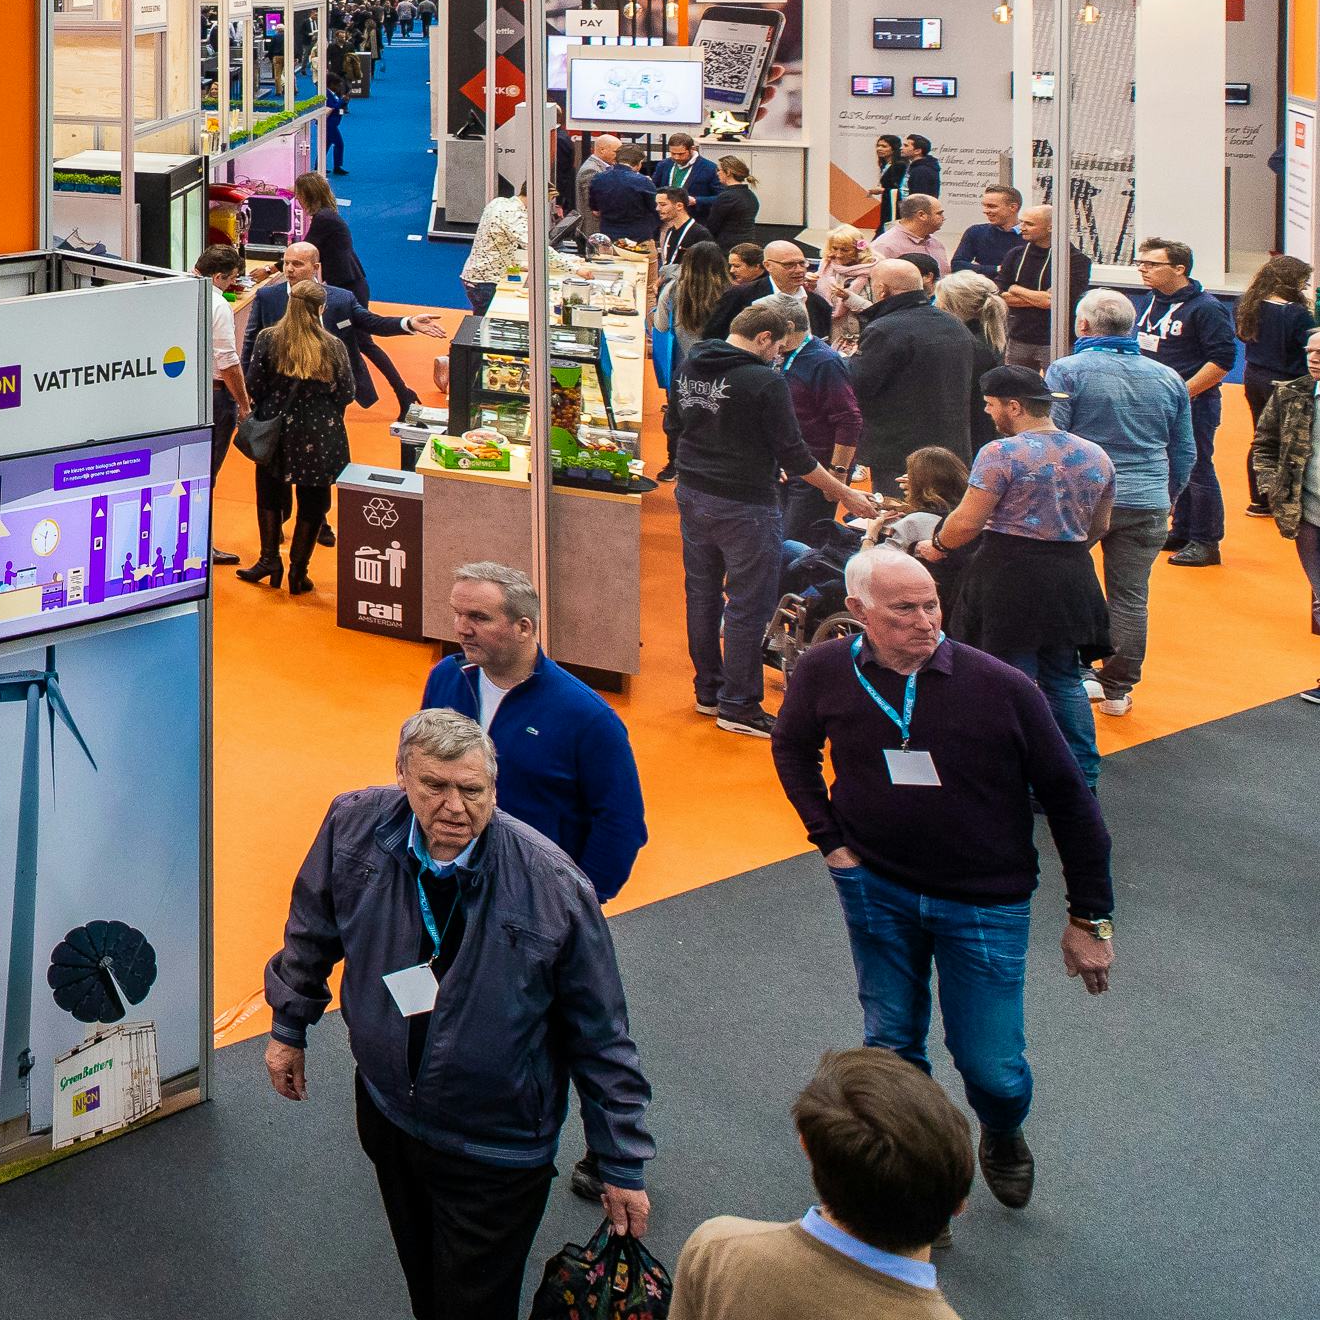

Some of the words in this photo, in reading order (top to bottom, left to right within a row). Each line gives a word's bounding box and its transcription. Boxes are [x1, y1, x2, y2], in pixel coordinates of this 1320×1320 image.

[580, 19, 603, 28] PAY
[864, 111, 893, 125] brengt
[894, 112, 911, 121] rust
[912, 112, 921, 122] in
[922, 112, 933, 122] de
[935, 112, 965, 122] keuken
[33, 356, 157, 393] VATTENFALL
[95, 462, 116, 470] biologisch
[90, 470, 105, 478] groene
[358, 600, 403, 622] rai
[358, 615, 403, 628] AMSTERDAM
